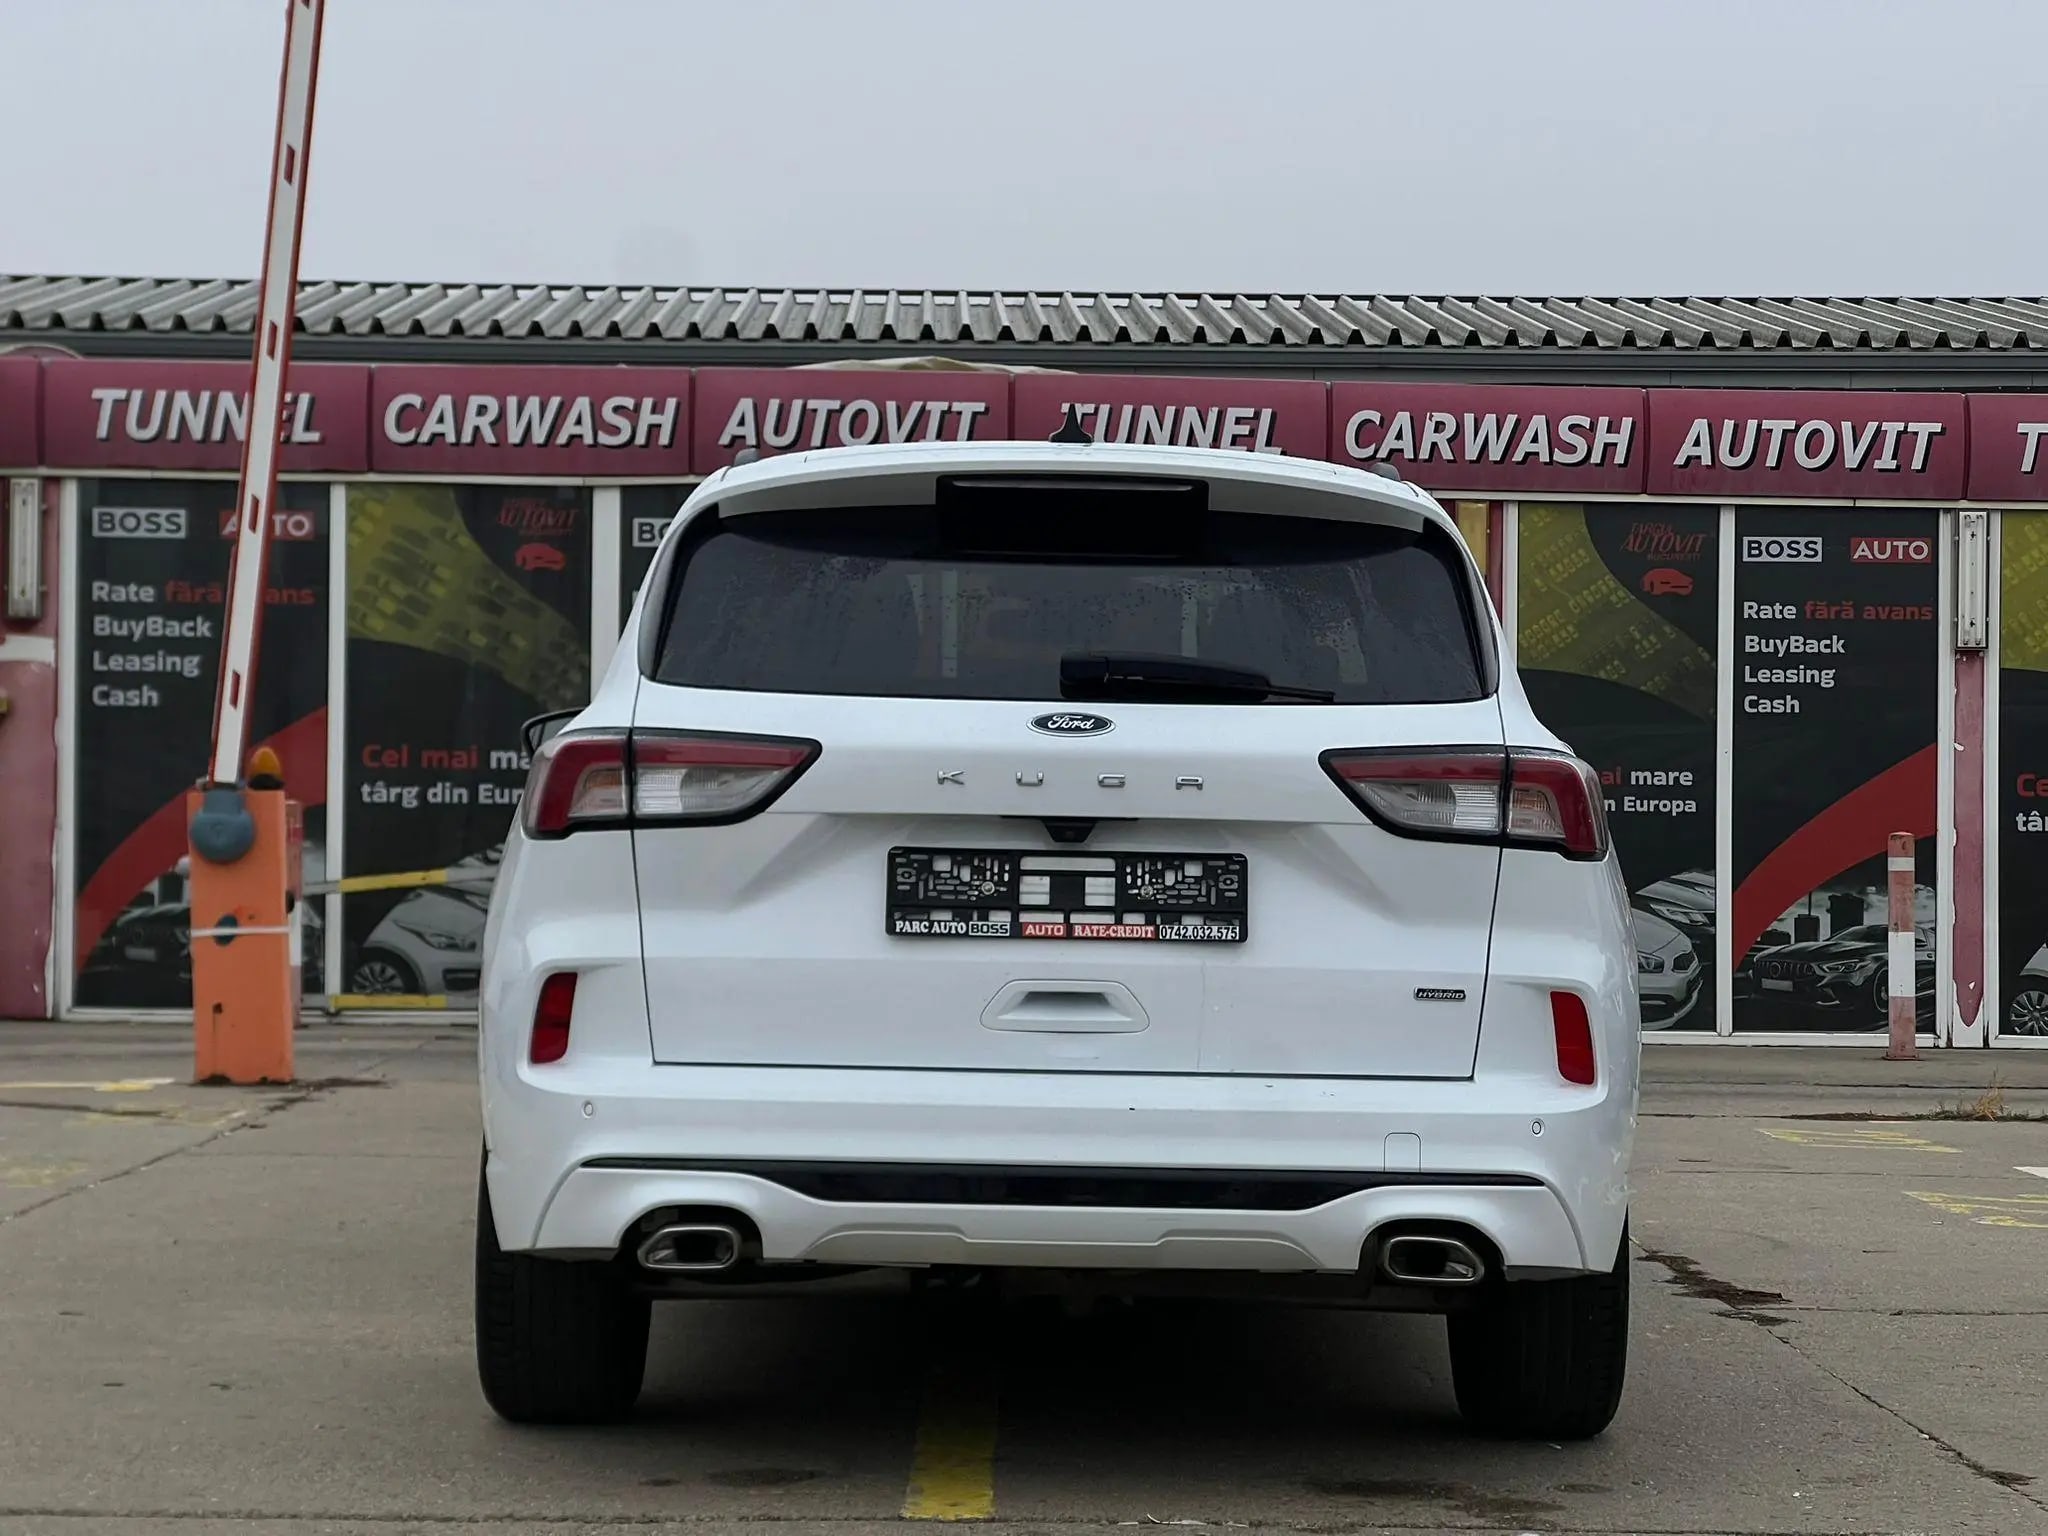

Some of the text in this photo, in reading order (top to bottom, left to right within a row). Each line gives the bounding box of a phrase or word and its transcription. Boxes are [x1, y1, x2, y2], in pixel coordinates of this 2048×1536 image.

[384, 394, 678, 447] CARWASH
[719, 398, 985, 446] AUTOVIT
[1345, 409, 1634, 466] CARWASH
[1673, 418, 1942, 471] AUTOVIT
[97, 512, 310, 536] BOSS ATO
[1747, 540, 1929, 560] BOSS AUTO
[92, 581, 155, 602] Rate
[1743, 600, 1933, 620] Rate fără avans
[93, 615, 212, 642] BuyBack
[1744, 635, 1845, 657] BuyBack
[93, 650, 201, 677] Leasing
[1744, 665, 1835, 688] Leasing
[92, 685, 160, 707] Cash
[1743, 695, 1800, 713] Cash
[1047, 714, 1095, 730] Ford
[362, 745, 408, 769] Cel
[421, 745, 478, 769] mai
[937, 768, 1204, 791] KUGA
[1630, 770, 1694, 786] mare
[361, 781, 419, 808] târg
[426, 781, 468, 805] din
[1623, 796, 1697, 817] Europa
[895, 921, 1238, 940] PARC AUTO BOSS AUTO RATE-CREDIT 0742.032.575
[1418, 991, 1464, 999] HYBRID
